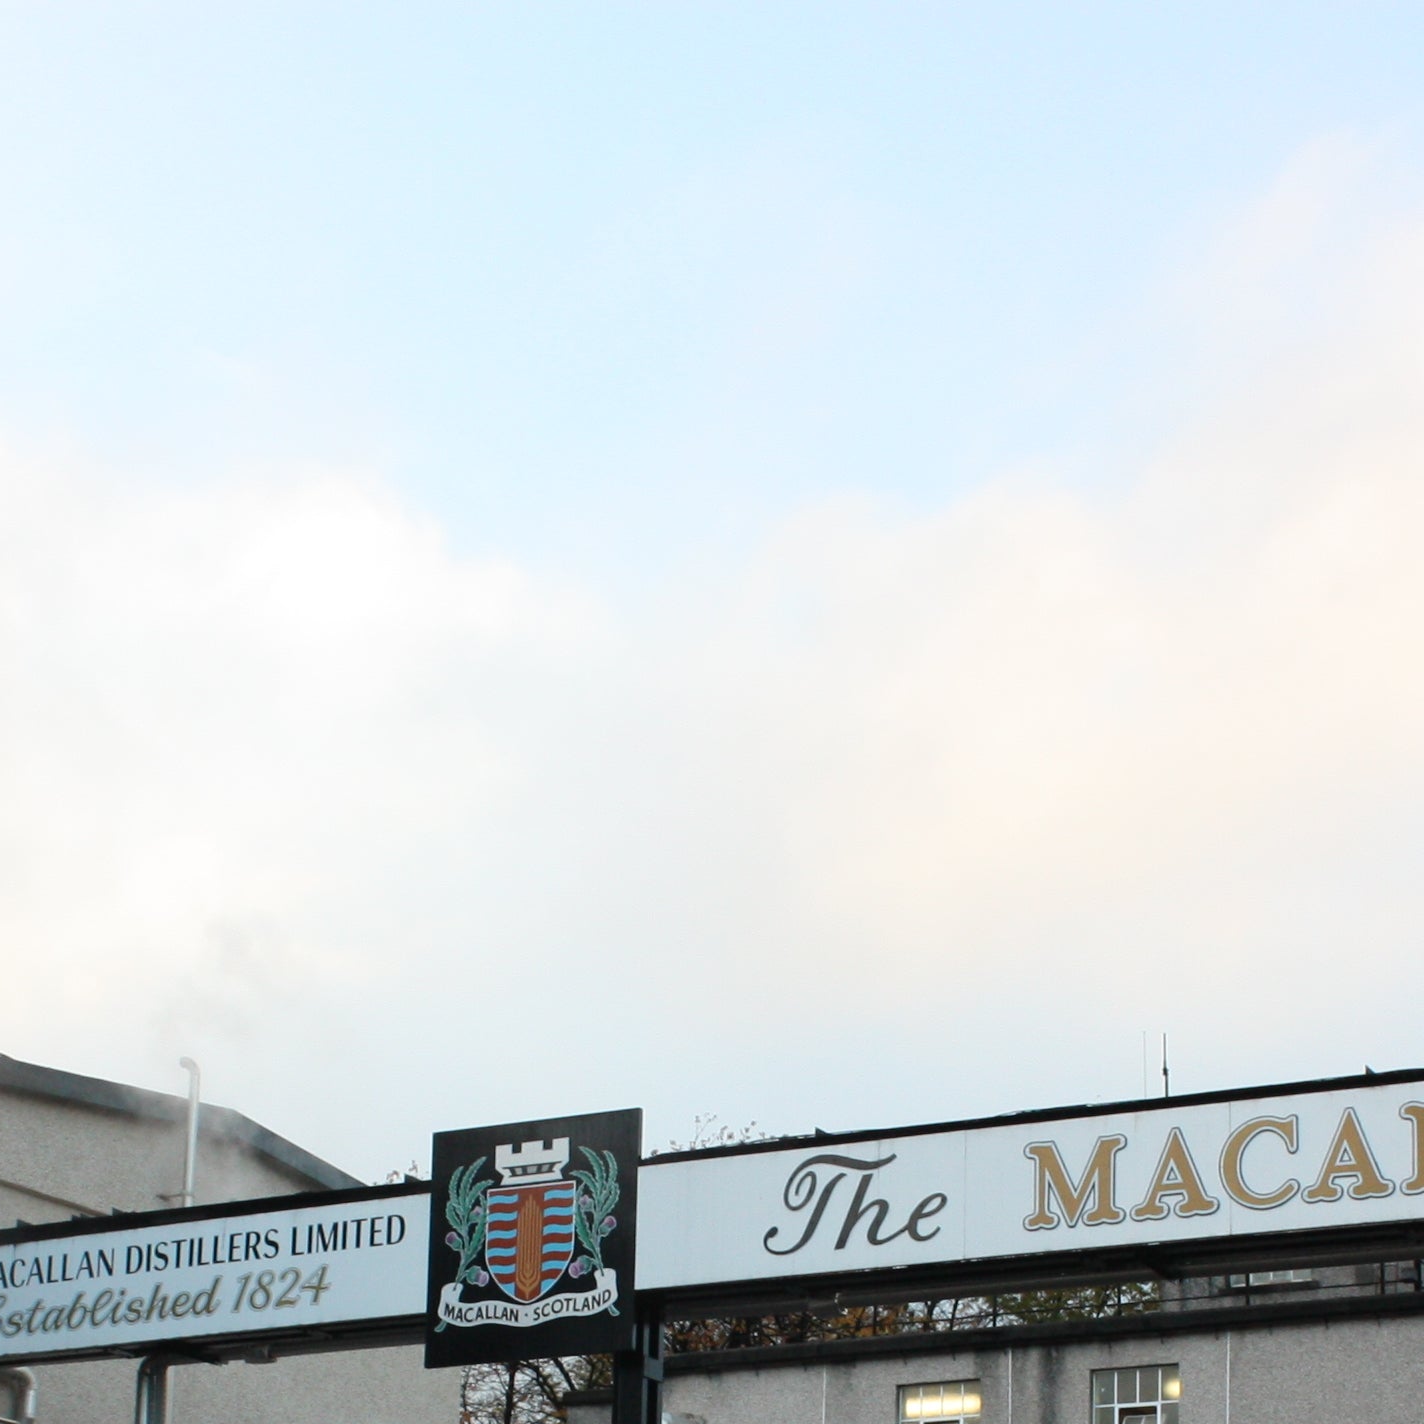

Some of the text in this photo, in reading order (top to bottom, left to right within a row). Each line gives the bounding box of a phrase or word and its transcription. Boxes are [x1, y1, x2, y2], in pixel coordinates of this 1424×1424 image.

[763, 1153, 948, 1256] The
[126, 1228, 280, 1275] DISTILLERS
[291, 1214, 406, 1257] LIMITED
[231, 1264, 332, 1315] 1824
[443, 1289, 612, 1323] MACALLAN SCOTLAND
